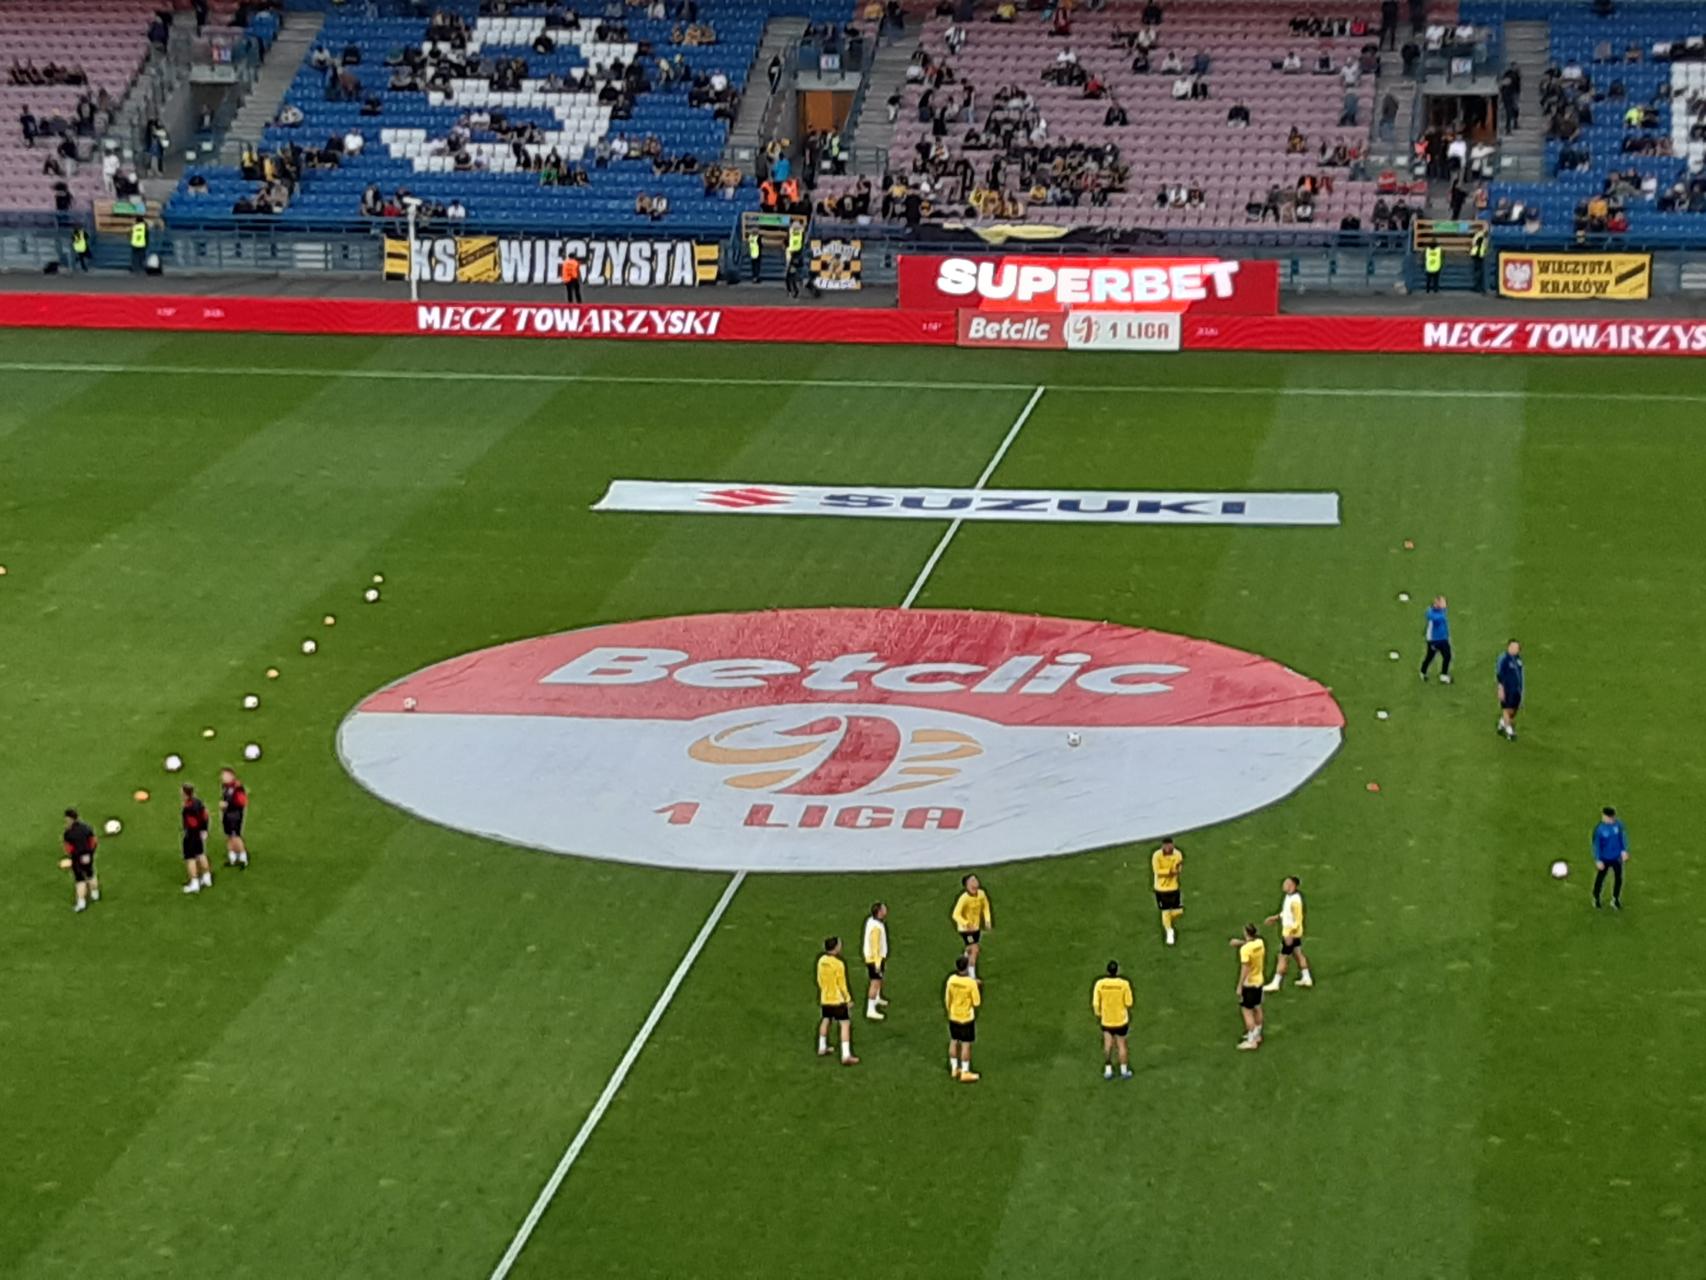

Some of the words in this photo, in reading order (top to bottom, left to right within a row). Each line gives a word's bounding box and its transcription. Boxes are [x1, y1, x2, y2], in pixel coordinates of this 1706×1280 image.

[411, 239, 455, 281] KS
[937, 258, 1239, 303] SUPERBET
[1540, 279, 1610, 294] KRAKÓW
[417, 305, 506, 332] MECZ
[512, 308, 721, 334] TOWARZYSKI
[968, 317, 1050, 341] Betclic
[1126, 322, 1169, 340] LIGA
[1424, 323, 1519, 347] MECZ
[818, 491, 1248, 516] SUZUKI
[540, 648, 1188, 695] Betclic
[653, 802, 702, 825] 1
[743, 803, 966, 831] LIGA
